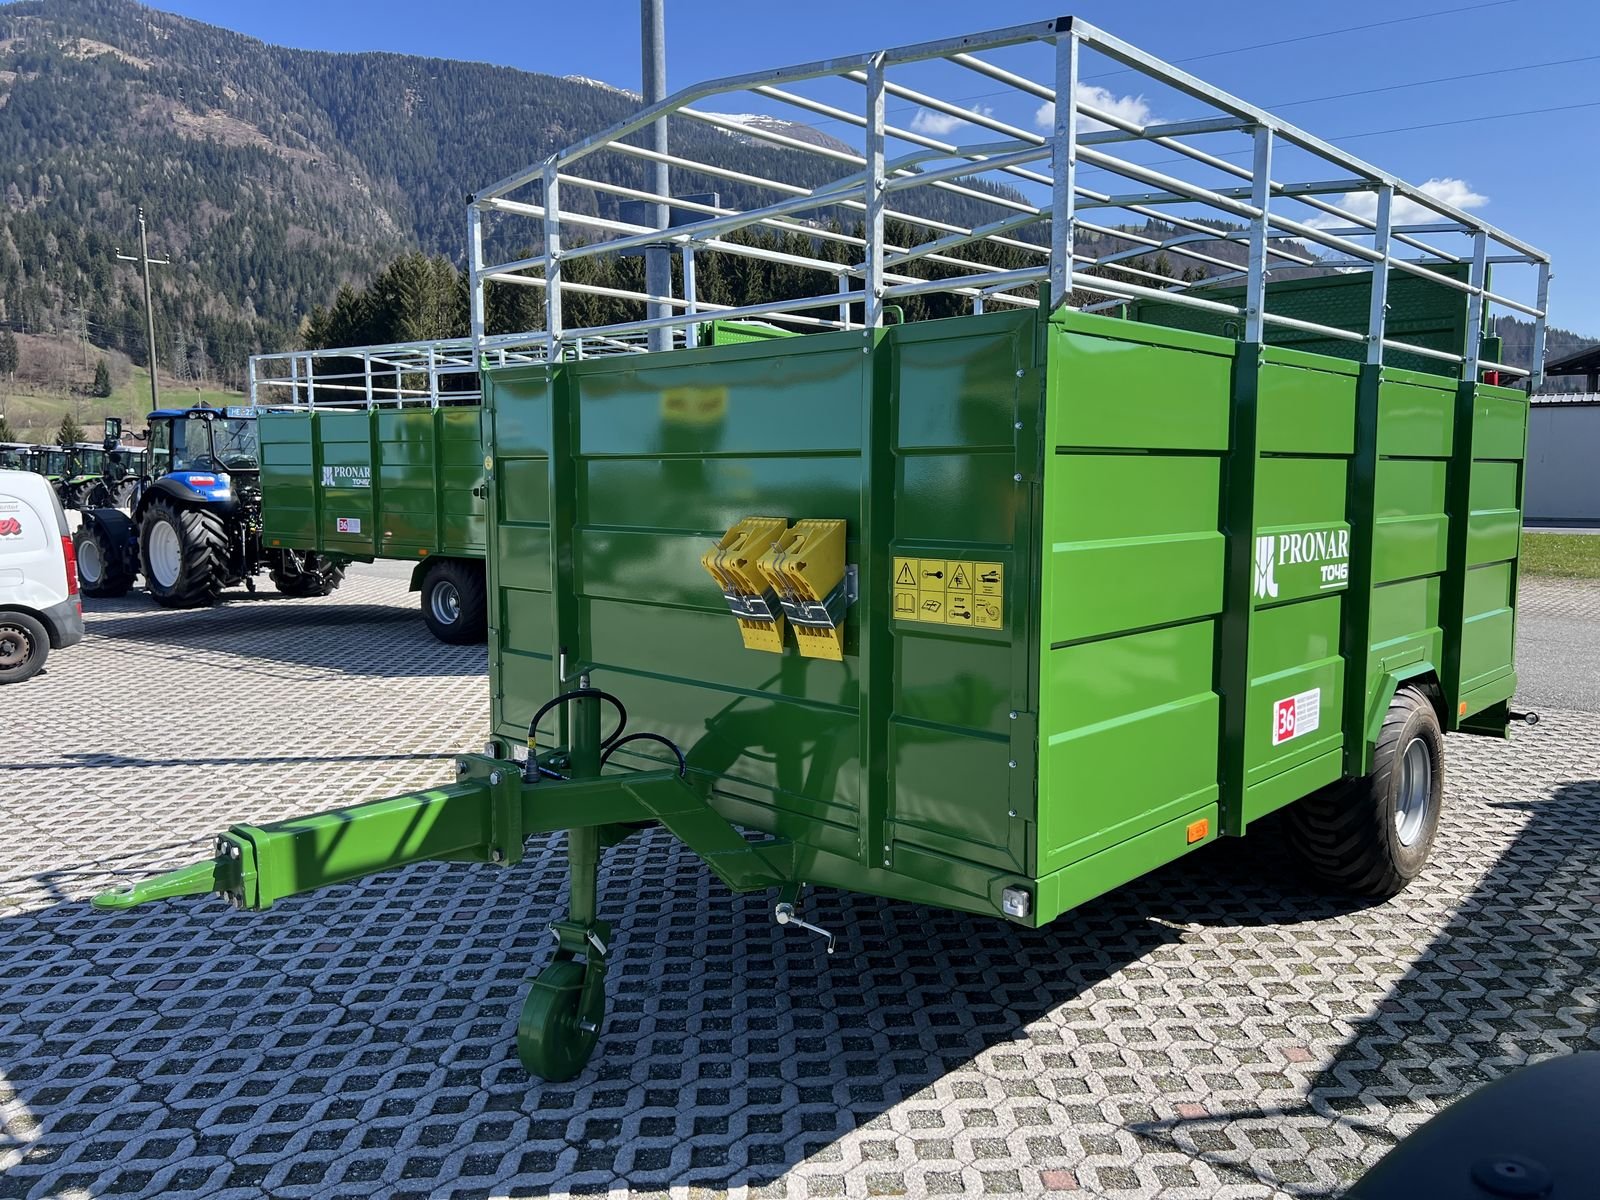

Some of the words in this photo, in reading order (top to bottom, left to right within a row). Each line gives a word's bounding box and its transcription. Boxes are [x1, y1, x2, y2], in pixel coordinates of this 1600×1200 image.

[334, 466, 371, 478] PRONAR
[339, 520, 348, 530] 36
[1278, 529, 1349, 566] PRONAR
[1278, 705, 1295, 735] 36
